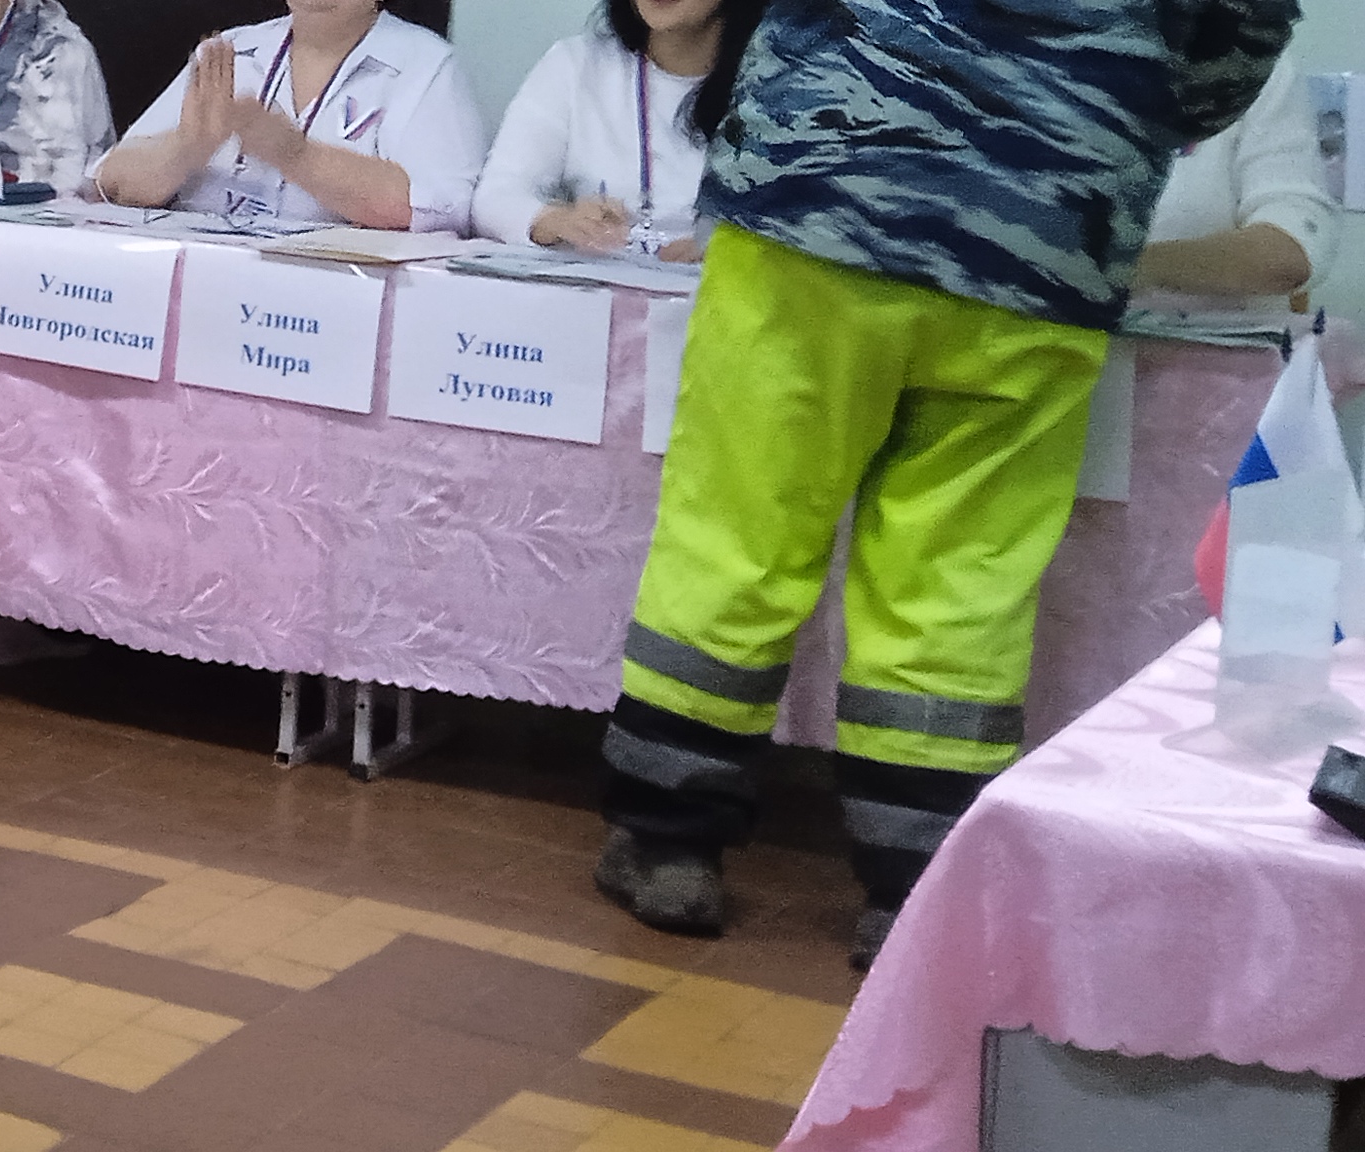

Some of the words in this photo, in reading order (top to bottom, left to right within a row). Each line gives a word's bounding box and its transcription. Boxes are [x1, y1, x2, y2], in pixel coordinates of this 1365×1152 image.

[39, 273, 113, 303] Улица
[240, 303, 320, 334] Улица
[240, 344, 311, 376] Мира
[456, 332, 544, 363] Улица
[439, 373, 553, 408] Луговая
